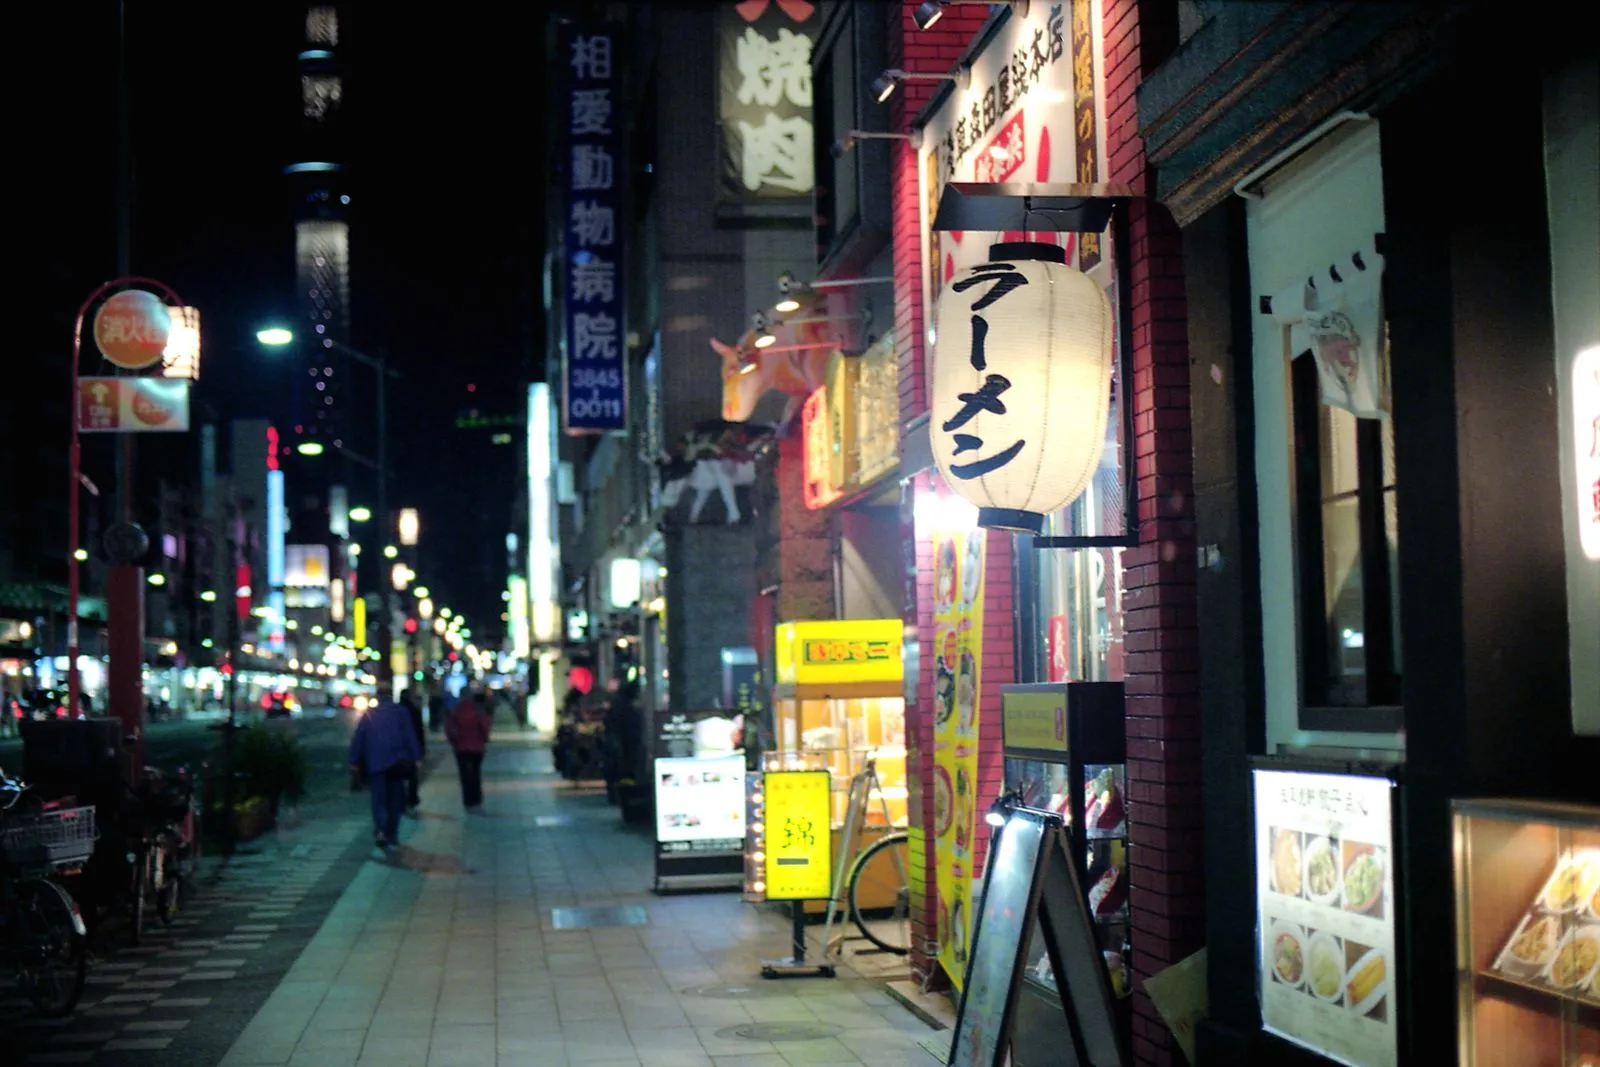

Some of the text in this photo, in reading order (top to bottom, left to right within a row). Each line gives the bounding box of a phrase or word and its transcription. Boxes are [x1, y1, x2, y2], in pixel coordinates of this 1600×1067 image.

[570, 34, 617, 360] 相愛動物病院
[736, 27, 814, 192] 焼肉
[571, 399, 621, 418] 0011
[942, 262, 1029, 480] ラーメン
